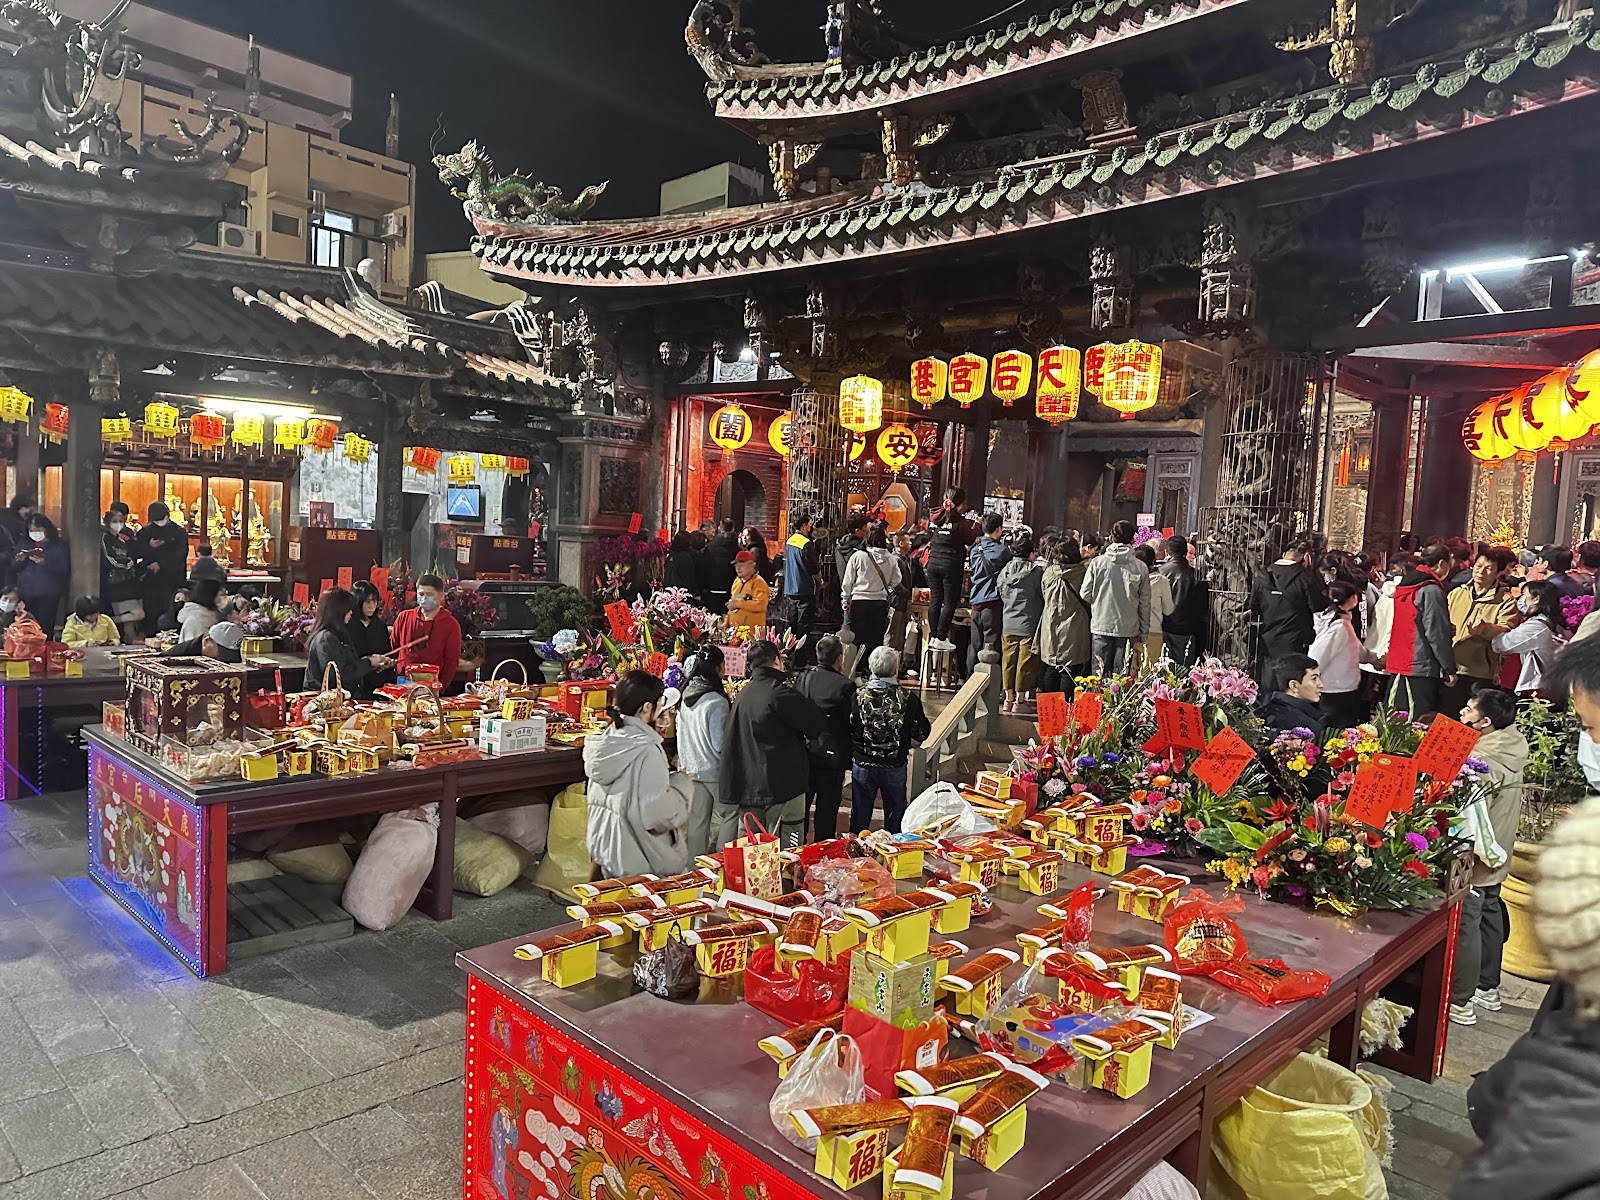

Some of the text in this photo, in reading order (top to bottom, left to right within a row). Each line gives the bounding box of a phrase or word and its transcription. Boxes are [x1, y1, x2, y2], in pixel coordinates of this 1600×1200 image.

[912, 361, 937, 397] 港
[949, 357, 980, 393] 宮
[992, 354, 1021, 390] 后
[1038, 349, 1066, 389] 天
[886, 432, 918, 459] 安
[326, 530, 357, 540] 點香台
[493, 539, 519, 548] 點香台
[512, 702, 527, 720] 福
[162, 799, 173, 827] 天
[1094, 819, 1114, 841] 福
[980, 861, 994, 887] 福
[1040, 865, 1053, 893] 福
[712, 941, 737, 974] 福
[848, 1134, 877, 1183] 福
